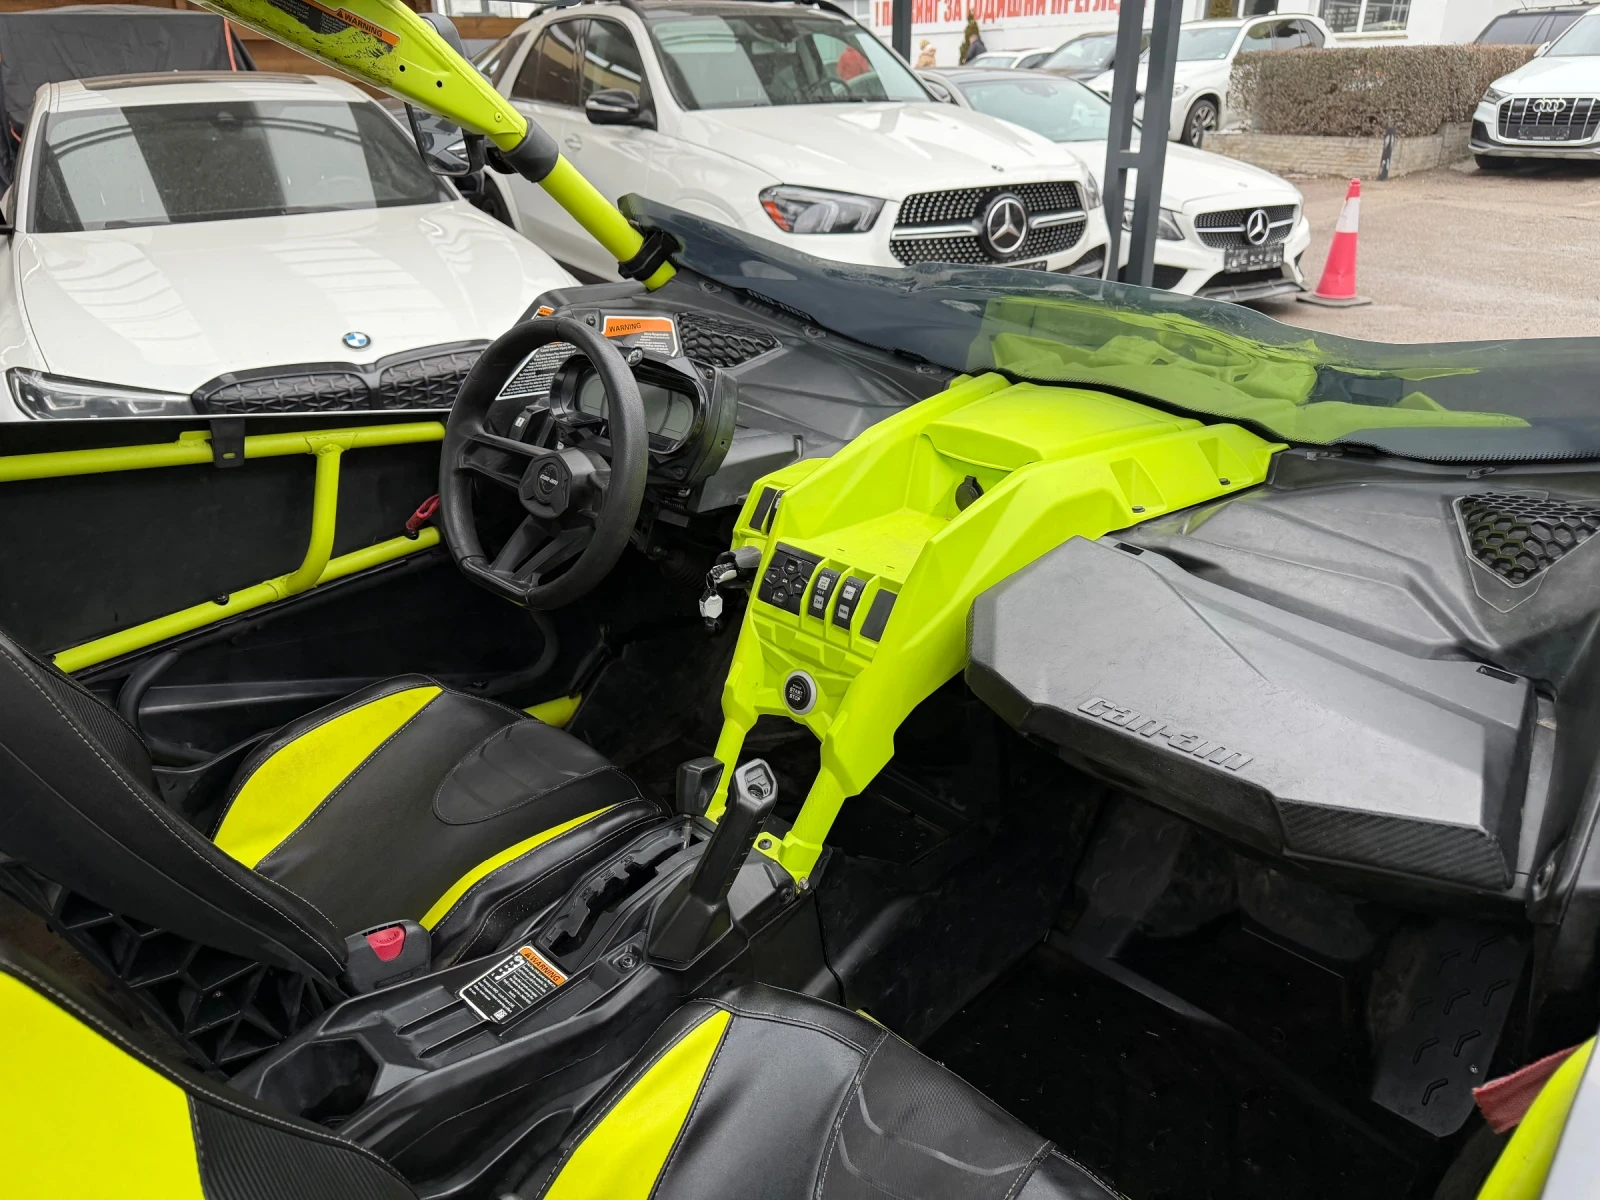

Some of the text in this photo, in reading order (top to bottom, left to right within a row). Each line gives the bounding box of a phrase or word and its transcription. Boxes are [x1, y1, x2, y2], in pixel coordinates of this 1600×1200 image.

[344, 12, 383, 38] WARNING
[882, 0, 941, 26] ПИНГ
[609, 322, 642, 333] WARNING
[1077, 697, 1253, 771] can-am
[530, 955, 561, 983] WARNING
